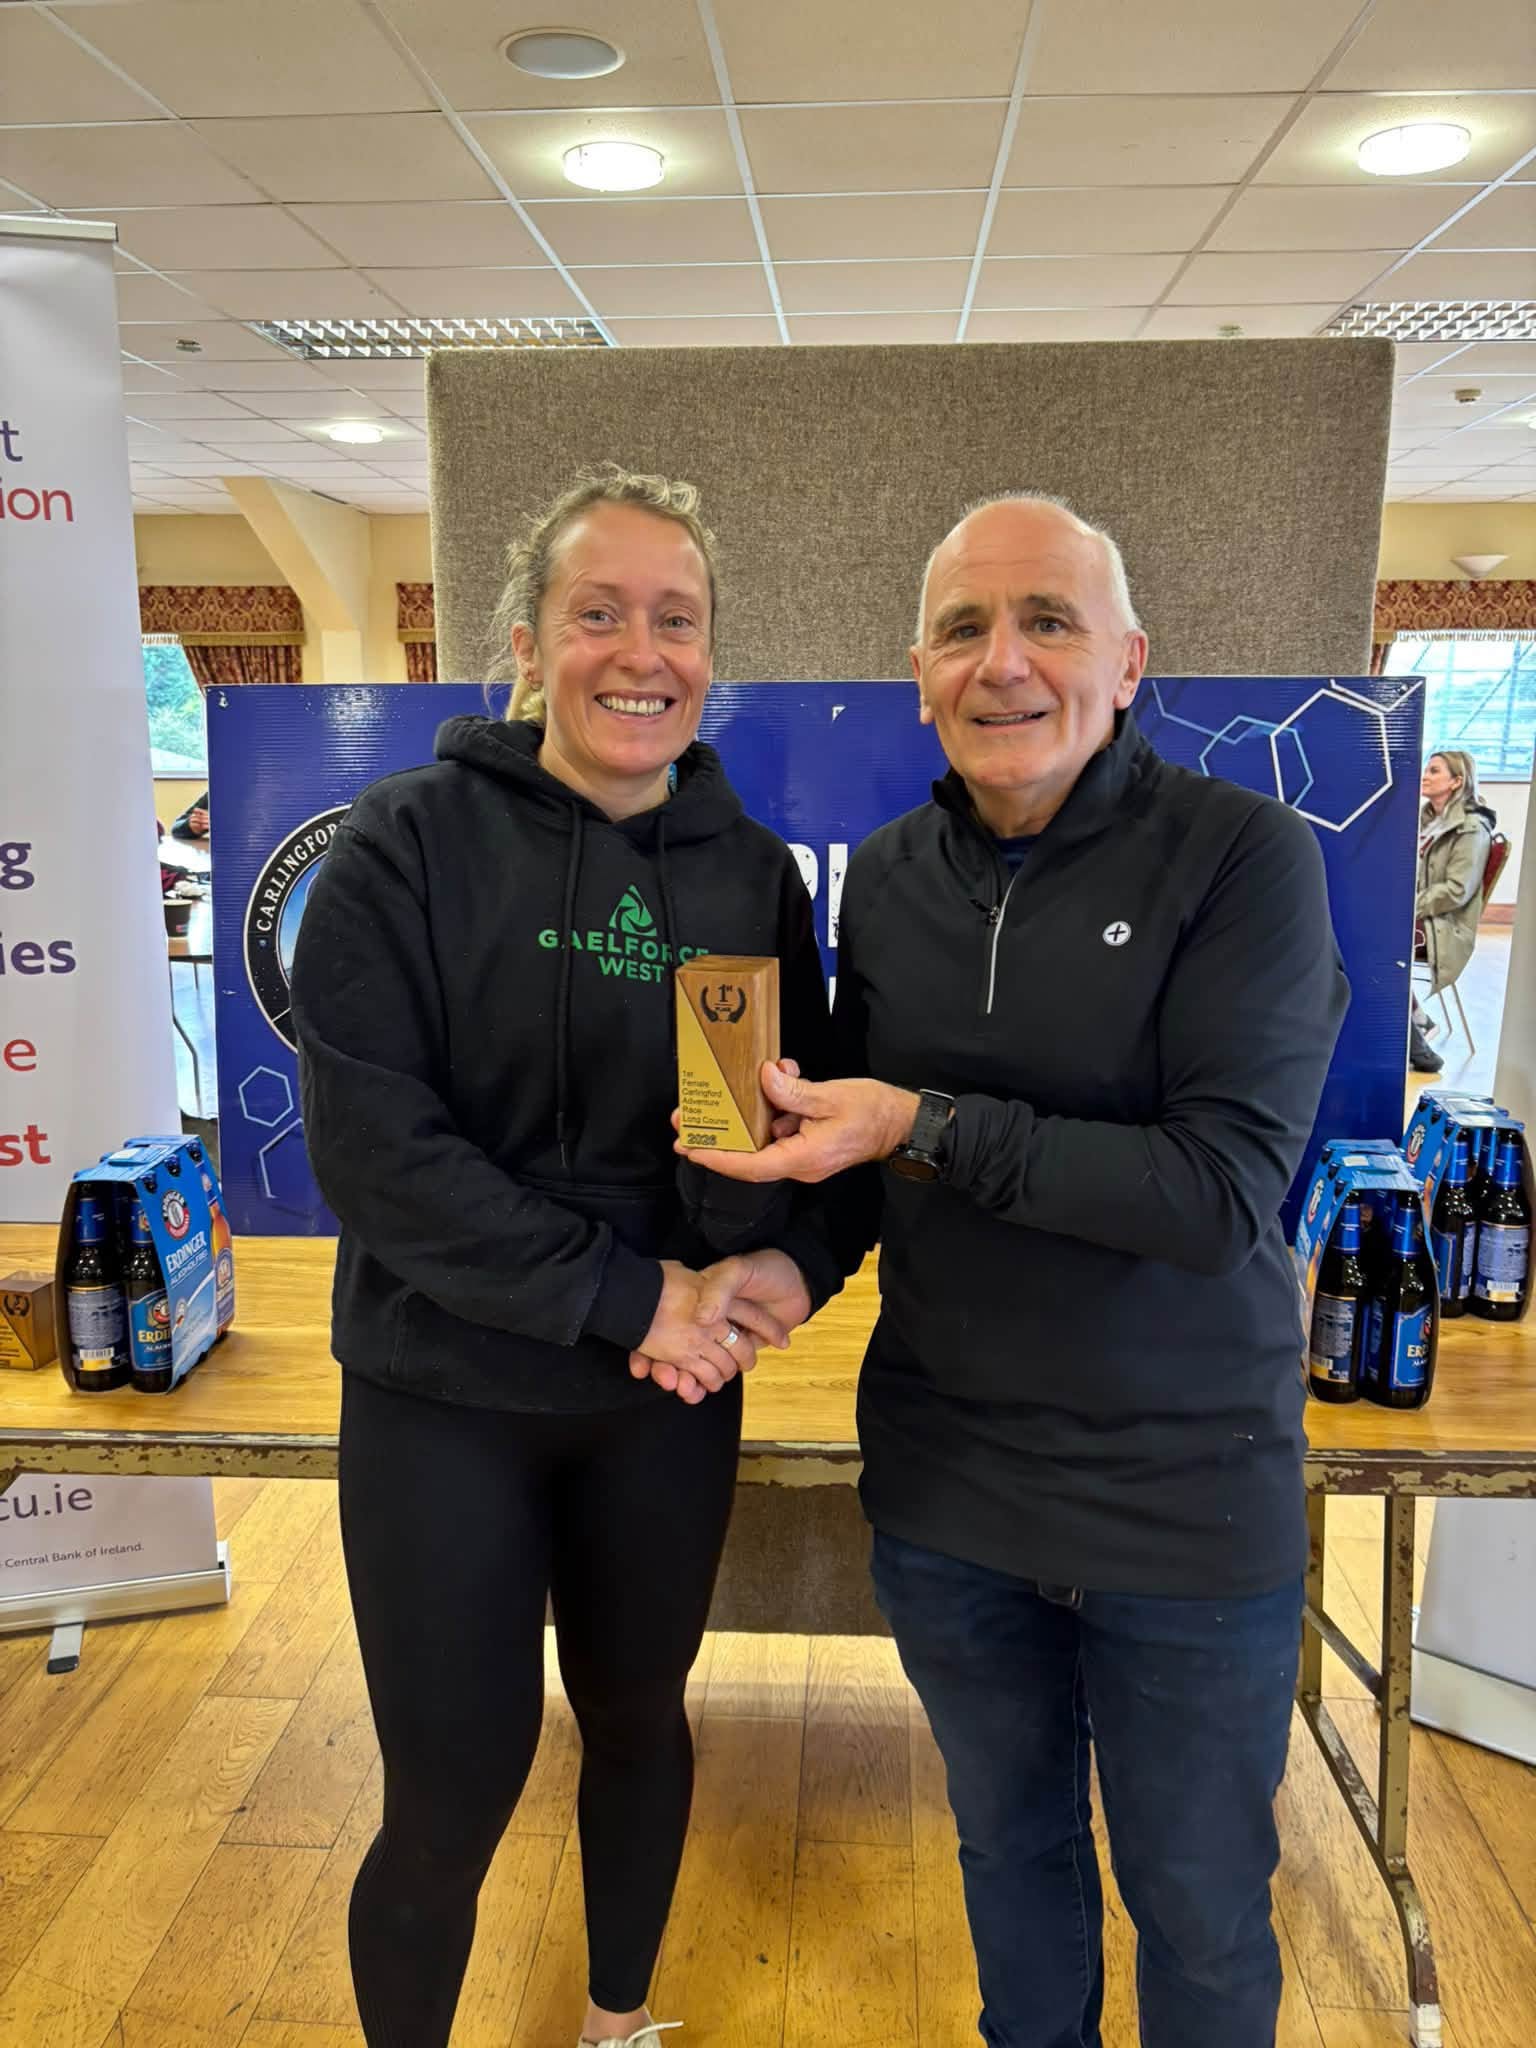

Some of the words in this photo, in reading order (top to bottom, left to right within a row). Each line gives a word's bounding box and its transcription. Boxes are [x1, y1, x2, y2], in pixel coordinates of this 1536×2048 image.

[598, 956, 665, 983] WEST
[682, 1079, 709, 1087] Female
[682, 1087, 722, 1098] Carlingford
[682, 1097, 719, 1106] Adventure
[682, 1105, 702, 1113] Race
[682, 1114, 701, 1124] Long
[703, 1116, 728, 1125] Course
[165, 1231, 207, 1274] ERDINGER
[5, 1553, 49, 1569] Central
[52, 1549, 82, 1563] Bank
[85, 1547, 97, 1558] of
